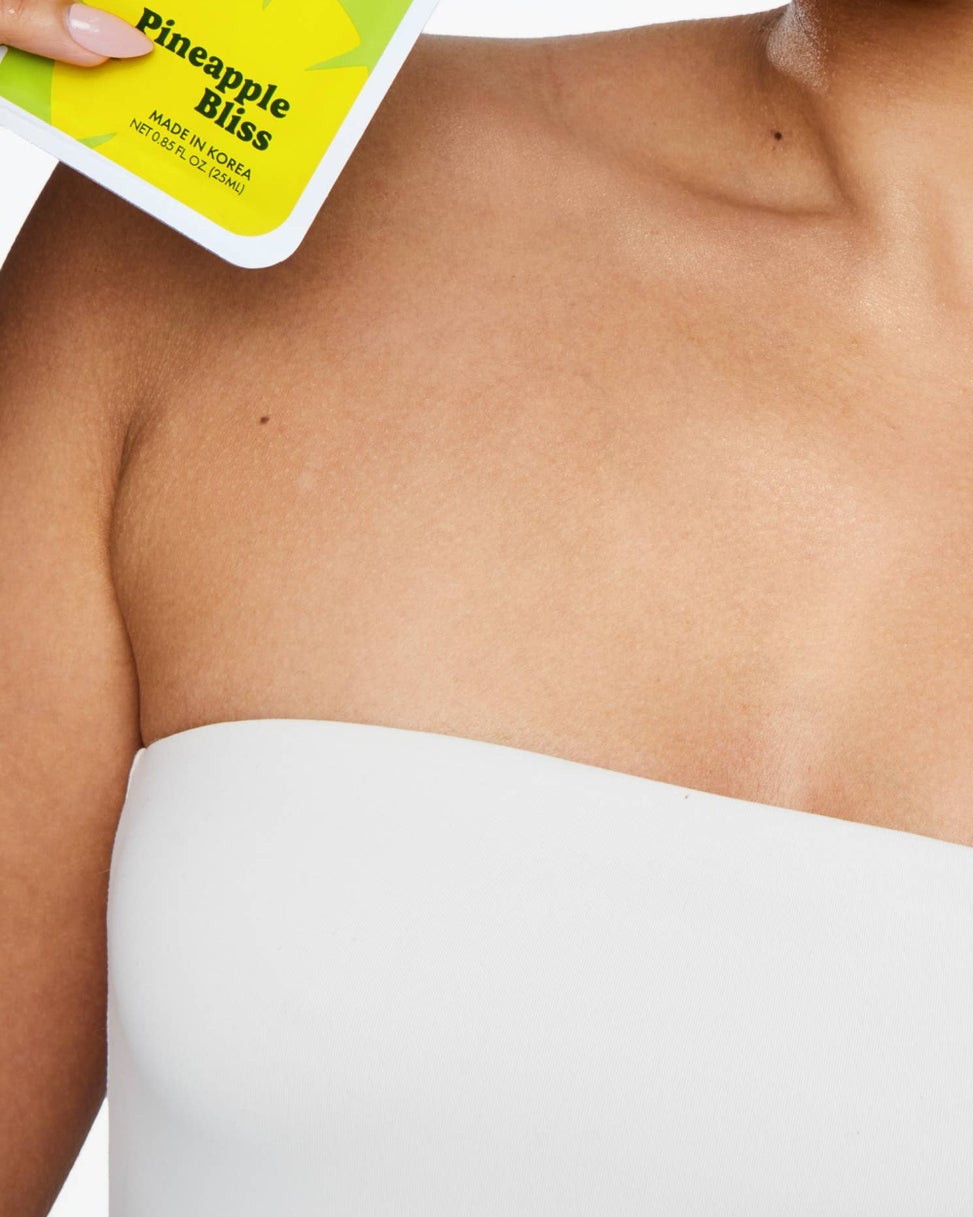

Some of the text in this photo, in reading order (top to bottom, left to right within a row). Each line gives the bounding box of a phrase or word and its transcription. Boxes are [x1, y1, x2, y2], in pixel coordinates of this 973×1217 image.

[135, 7, 291, 119] Pineapple
[129, 118, 154, 137] NET
[151, 131, 176, 152] 0.85
[174, 145, 187, 161] FL
[208, 166, 246, 196] (25ML)
[148, 110, 252, 182] MADE IN KOREA
[194, 87, 273, 152] Bliss
